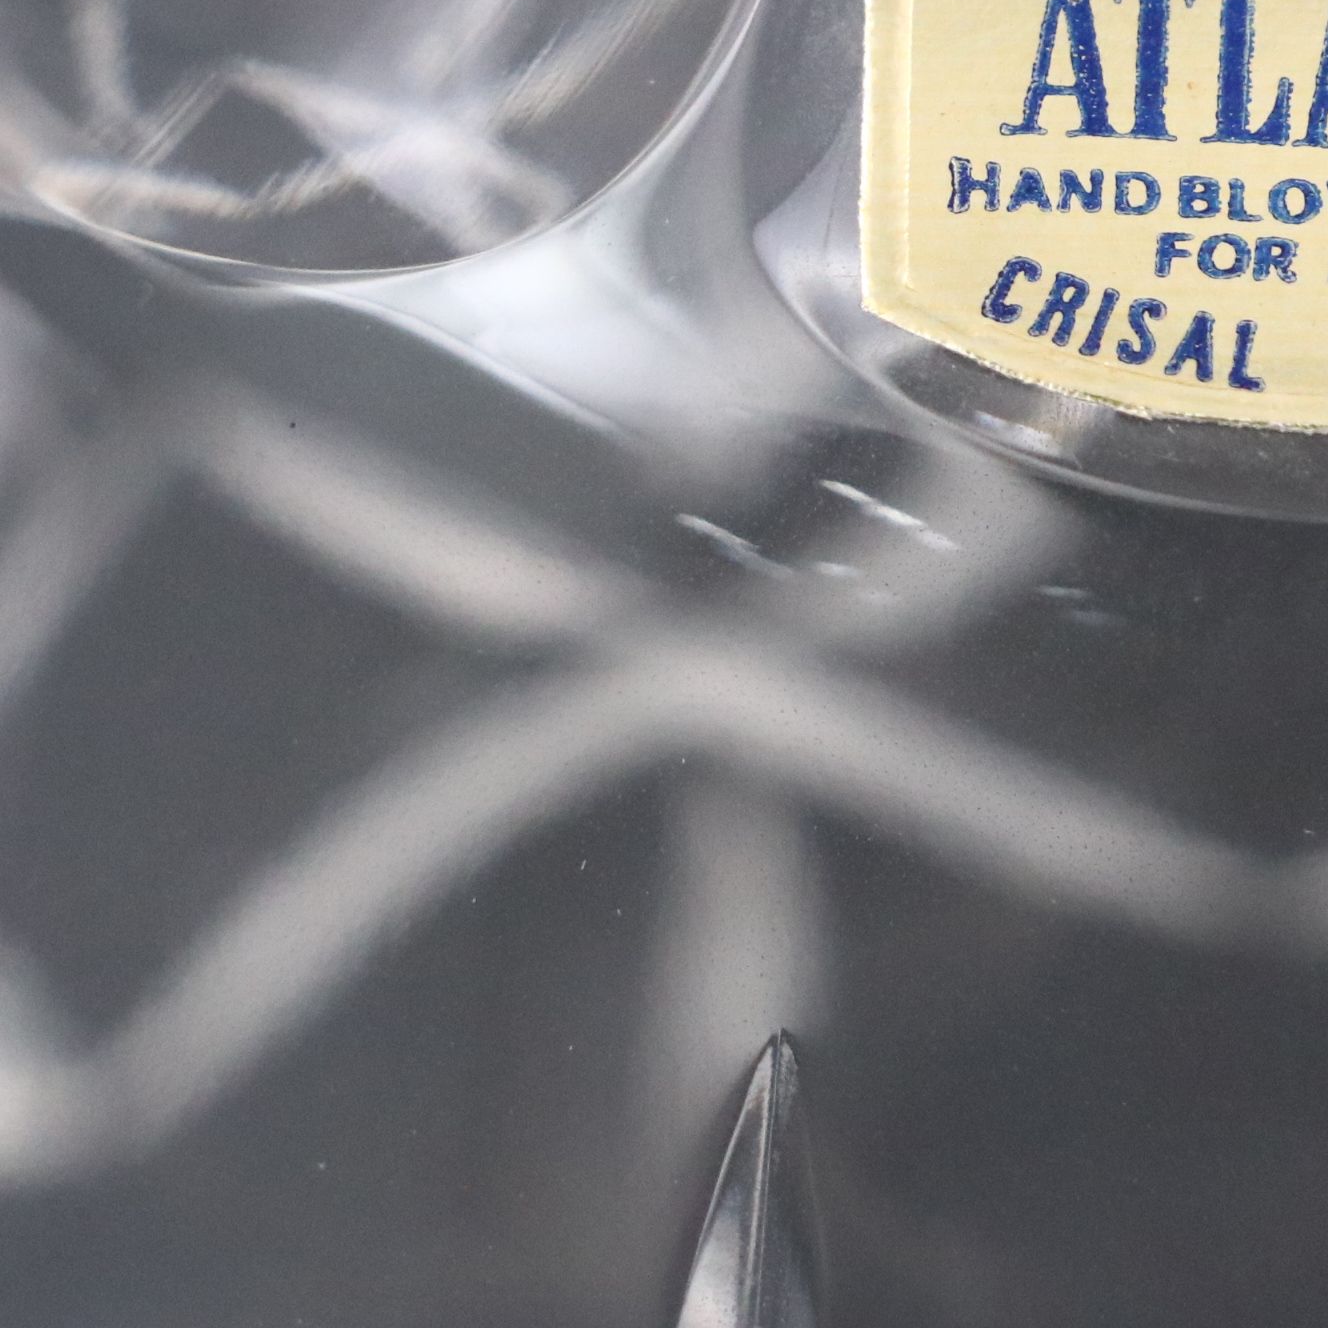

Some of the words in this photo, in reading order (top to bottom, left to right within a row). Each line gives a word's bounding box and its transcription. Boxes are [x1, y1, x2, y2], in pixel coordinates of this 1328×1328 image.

[947, 157, 1163, 216] HAND
[1153, 231, 1298, 283] FOR
[981, 255, 1265, 393] CRISAL
